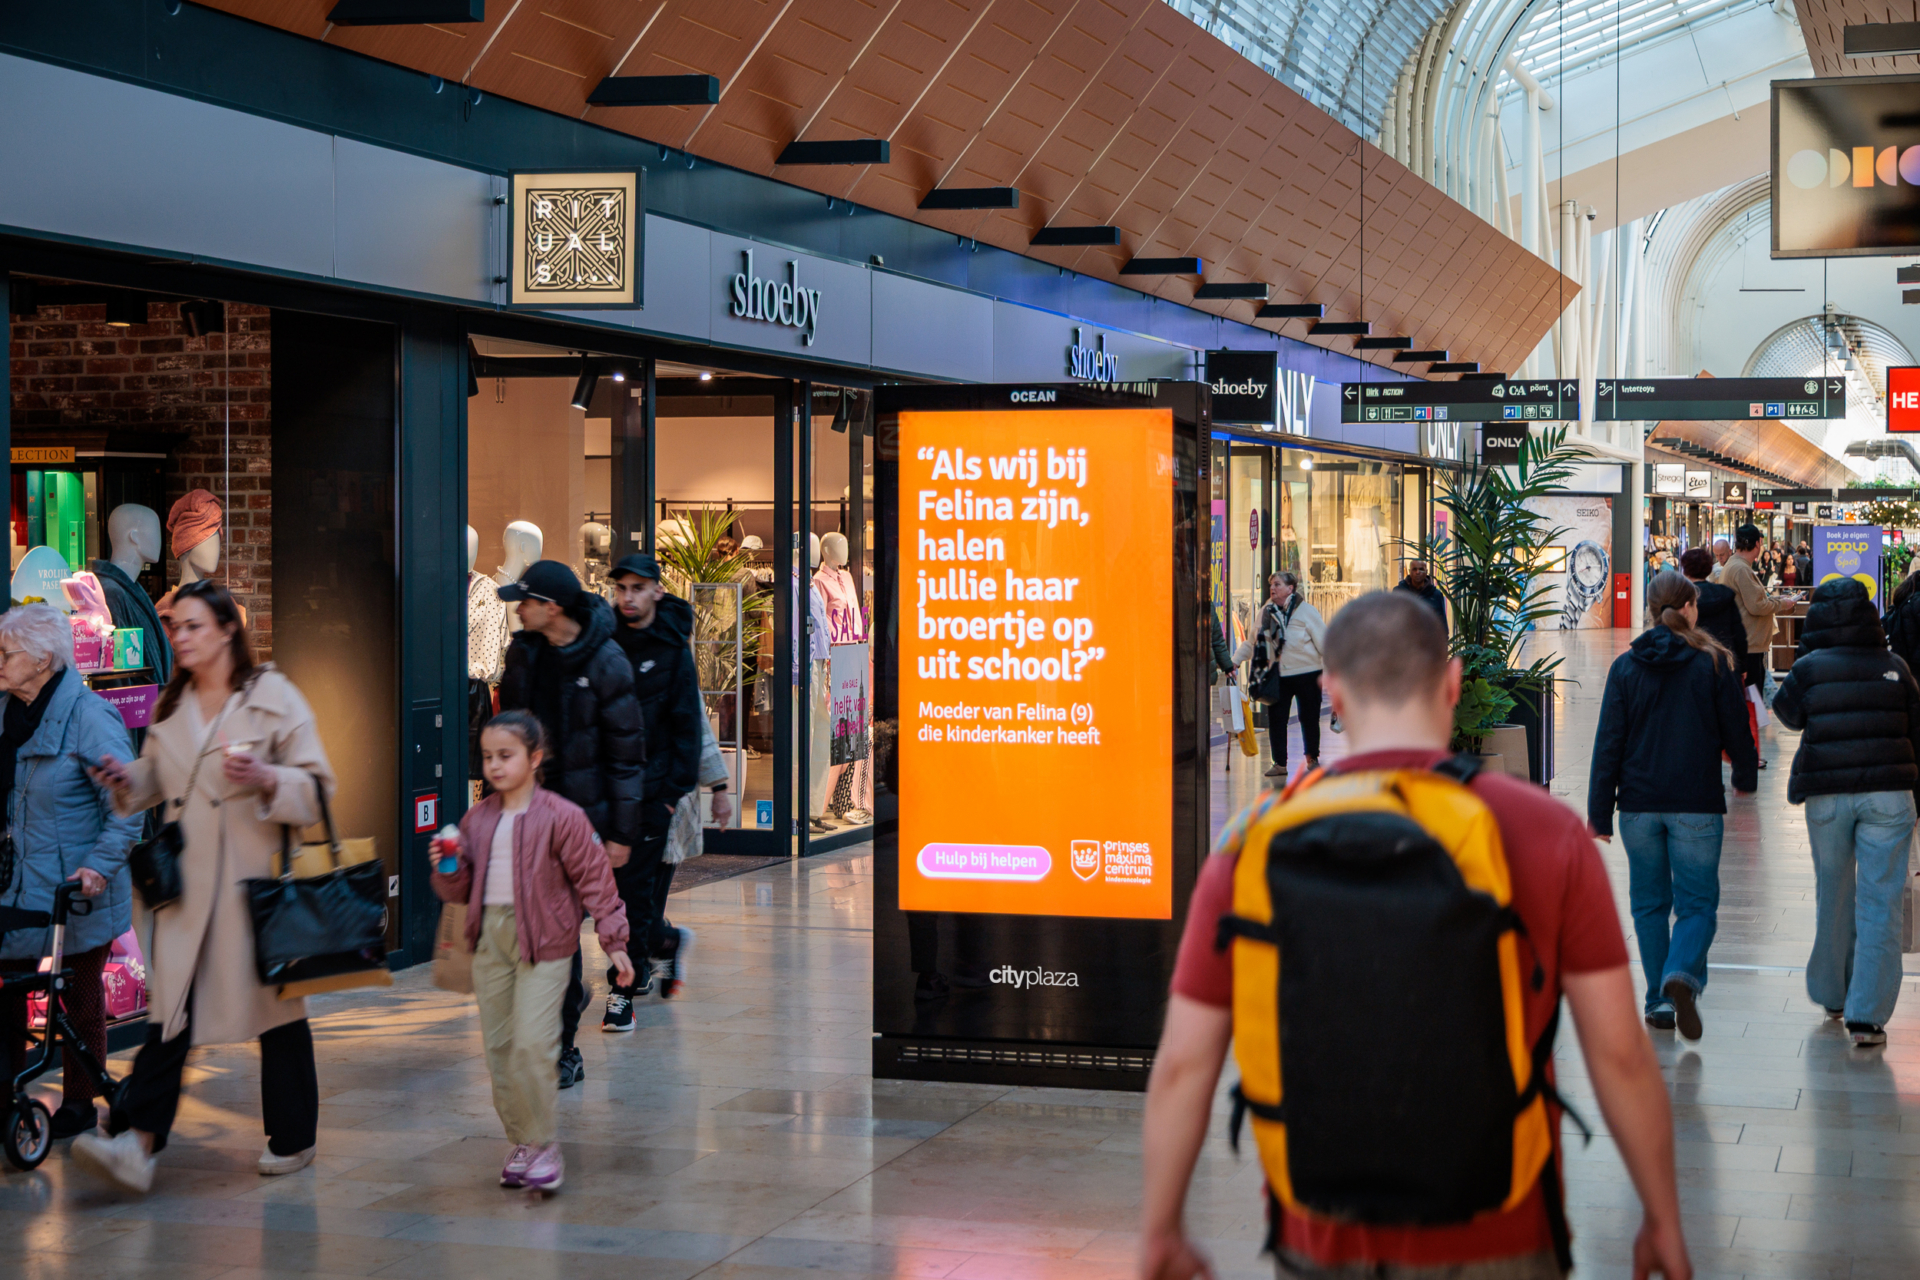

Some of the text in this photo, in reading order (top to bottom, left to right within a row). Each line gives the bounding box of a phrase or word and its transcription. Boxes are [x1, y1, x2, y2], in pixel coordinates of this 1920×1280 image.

[732, 248, 821, 346] shoeby
[1010, 390, 1056, 403] OCEAN
[1211, 378, 1268, 399] shoeby
[1365, 388, 1404, 397] Dirk ACTION
[1621, 385, 1655, 393] Intertoys
[1261, 367, 1315, 437] NLY
[1892, 391, 1919, 409] HE
[1416, 409, 1425, 417] P1
[1505, 408, 1514, 416] P1
[1768, 406, 1777, 414] P1
[1486, 437, 1523, 448] ONLY
[989, 448, 1038, 488] wij
[1047, 447, 1087, 488] bij
[1688, 476, 1708, 488] Etos
[918, 488, 1090, 529] Felina zijn,
[1576, 508, 1600, 518] SEIKO
[1826, 531, 1870, 540] Boek je eigen:
[918, 529, 1005, 561] halen
[38, 569, 69, 579] VROLIJK
[42, 580, 61, 590] PASE
[917, 568, 1079, 608] jullie haar
[831, 605, 868, 643] SALE
[917, 607, 1093, 649] broertje op
[917, 649, 961, 679] uit
[849, 678, 858, 688] SALE
[833, 695, 866, 715] helft van
[918, 702, 1093, 725] Moeder van Felina (9)
[835, 714, 865, 738] de helft
[918, 724, 1100, 745] die kinderkanker heeft
[423, 805, 429, 822] B
[1103, 840, 1149, 854] prinses
[935, 852, 1037, 871] Hulp bij helpen
[1105, 863, 1151, 876] centrum
[1105, 876, 1151, 885] kinderoncologie
[989, 964, 1079, 989] cityplaza
